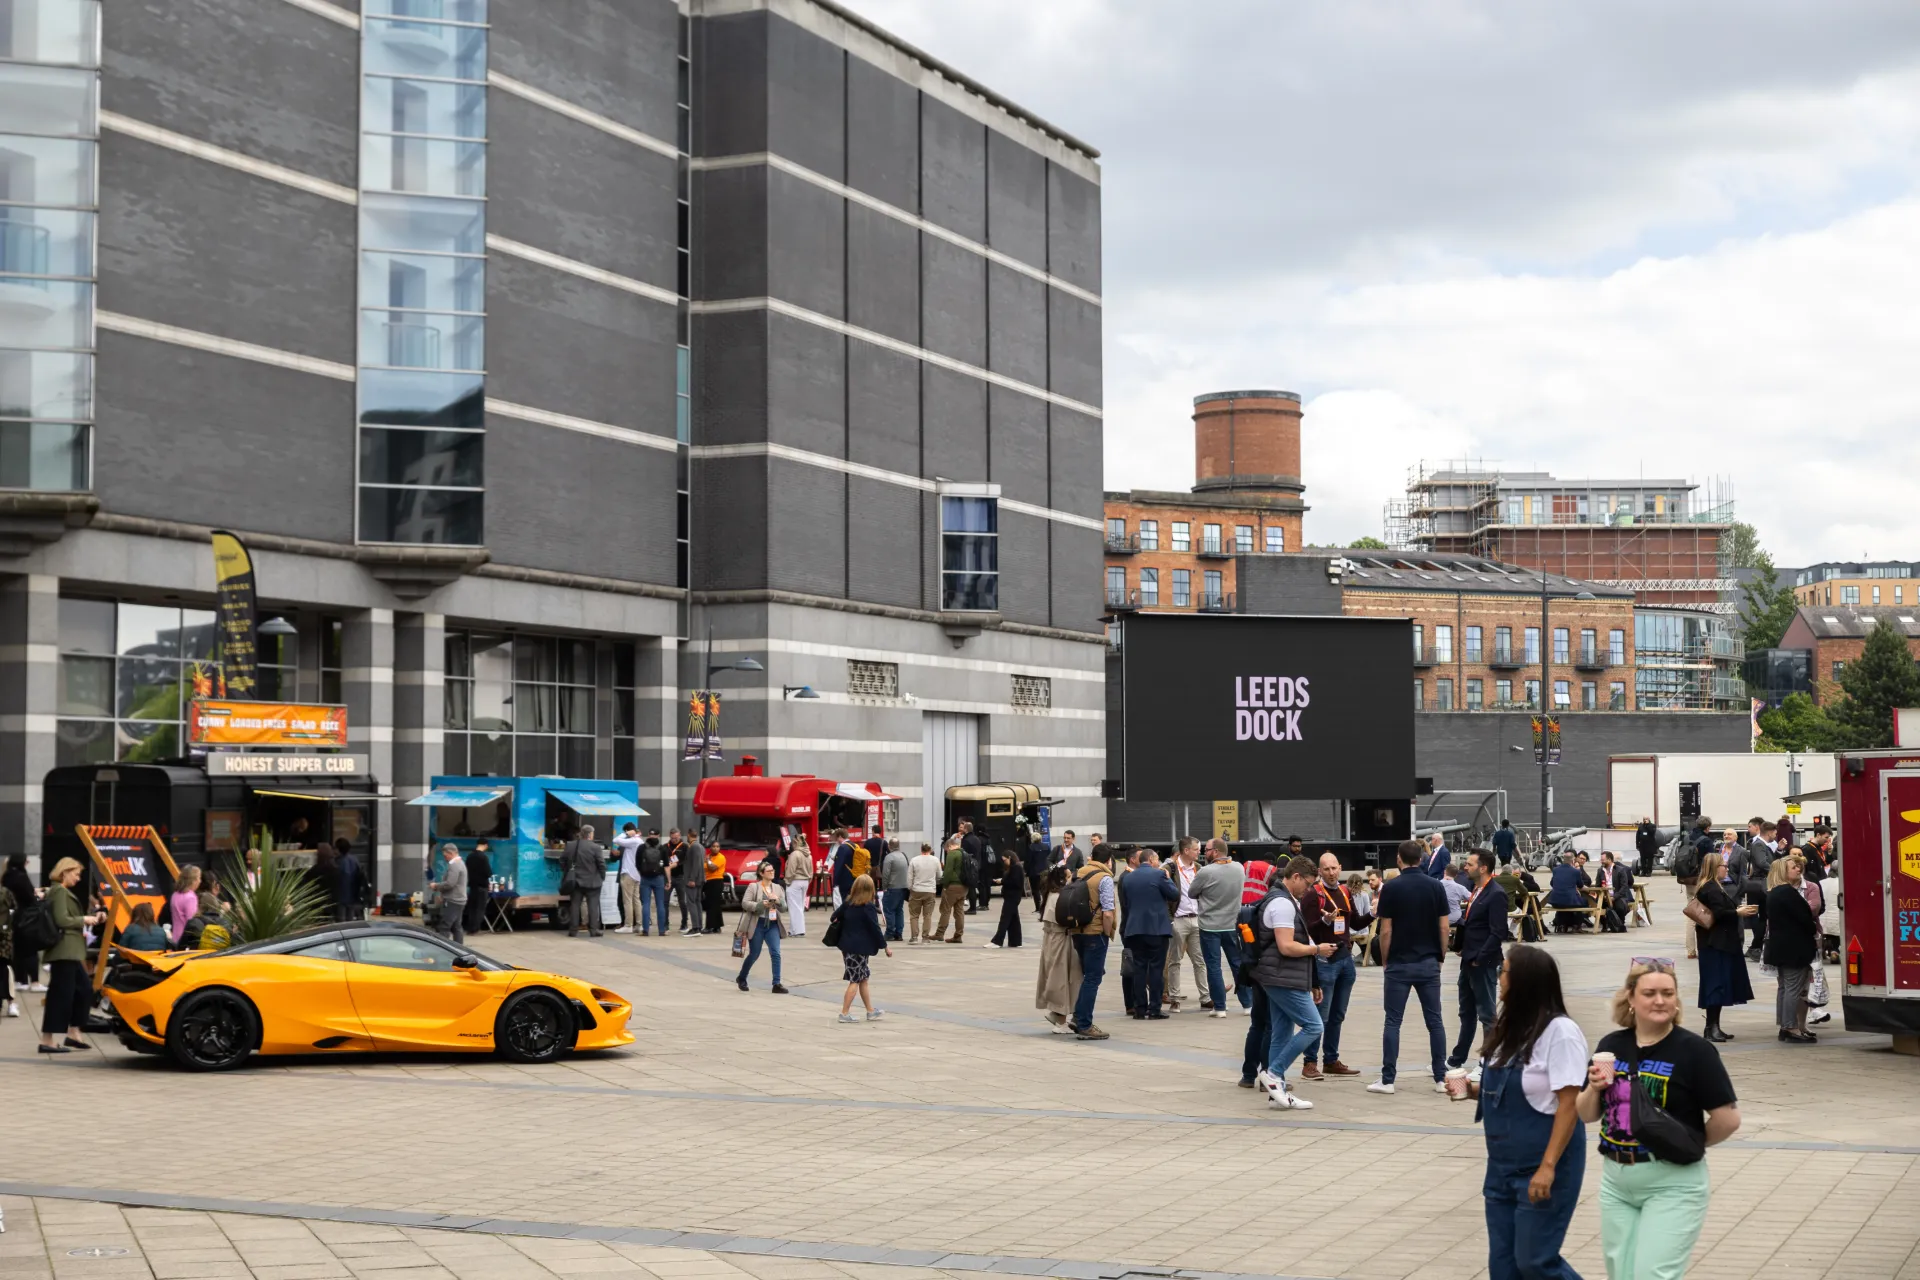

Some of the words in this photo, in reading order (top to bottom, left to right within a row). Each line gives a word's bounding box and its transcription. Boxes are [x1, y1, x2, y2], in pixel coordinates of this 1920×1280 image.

[1236, 676, 1310, 708] LEEDS
[1236, 709, 1303, 741] DOCK
[225, 756, 274, 772] HONEST
[277, 757, 322, 772] SUPPER
[325, 758, 355, 772] CLUB
